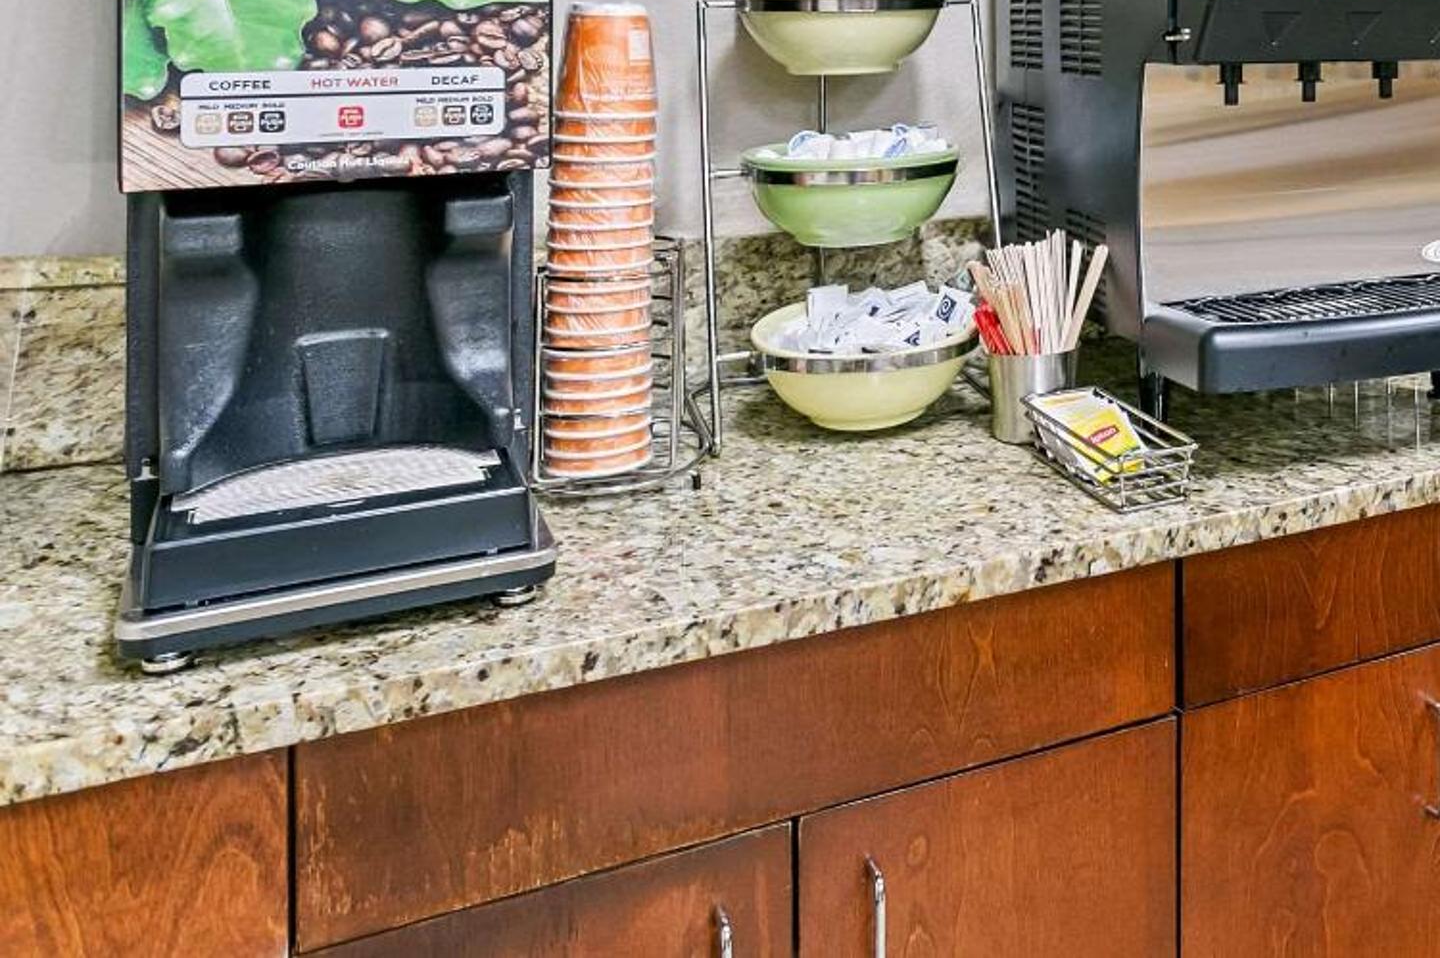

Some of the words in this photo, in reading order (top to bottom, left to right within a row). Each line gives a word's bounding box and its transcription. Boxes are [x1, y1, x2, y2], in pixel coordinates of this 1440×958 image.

[209, 80, 272, 91] COFFEE
[311, 78, 341, 88] HOT
[346, 76, 399, 87] WATER
[431, 75, 479, 85] DECAF
